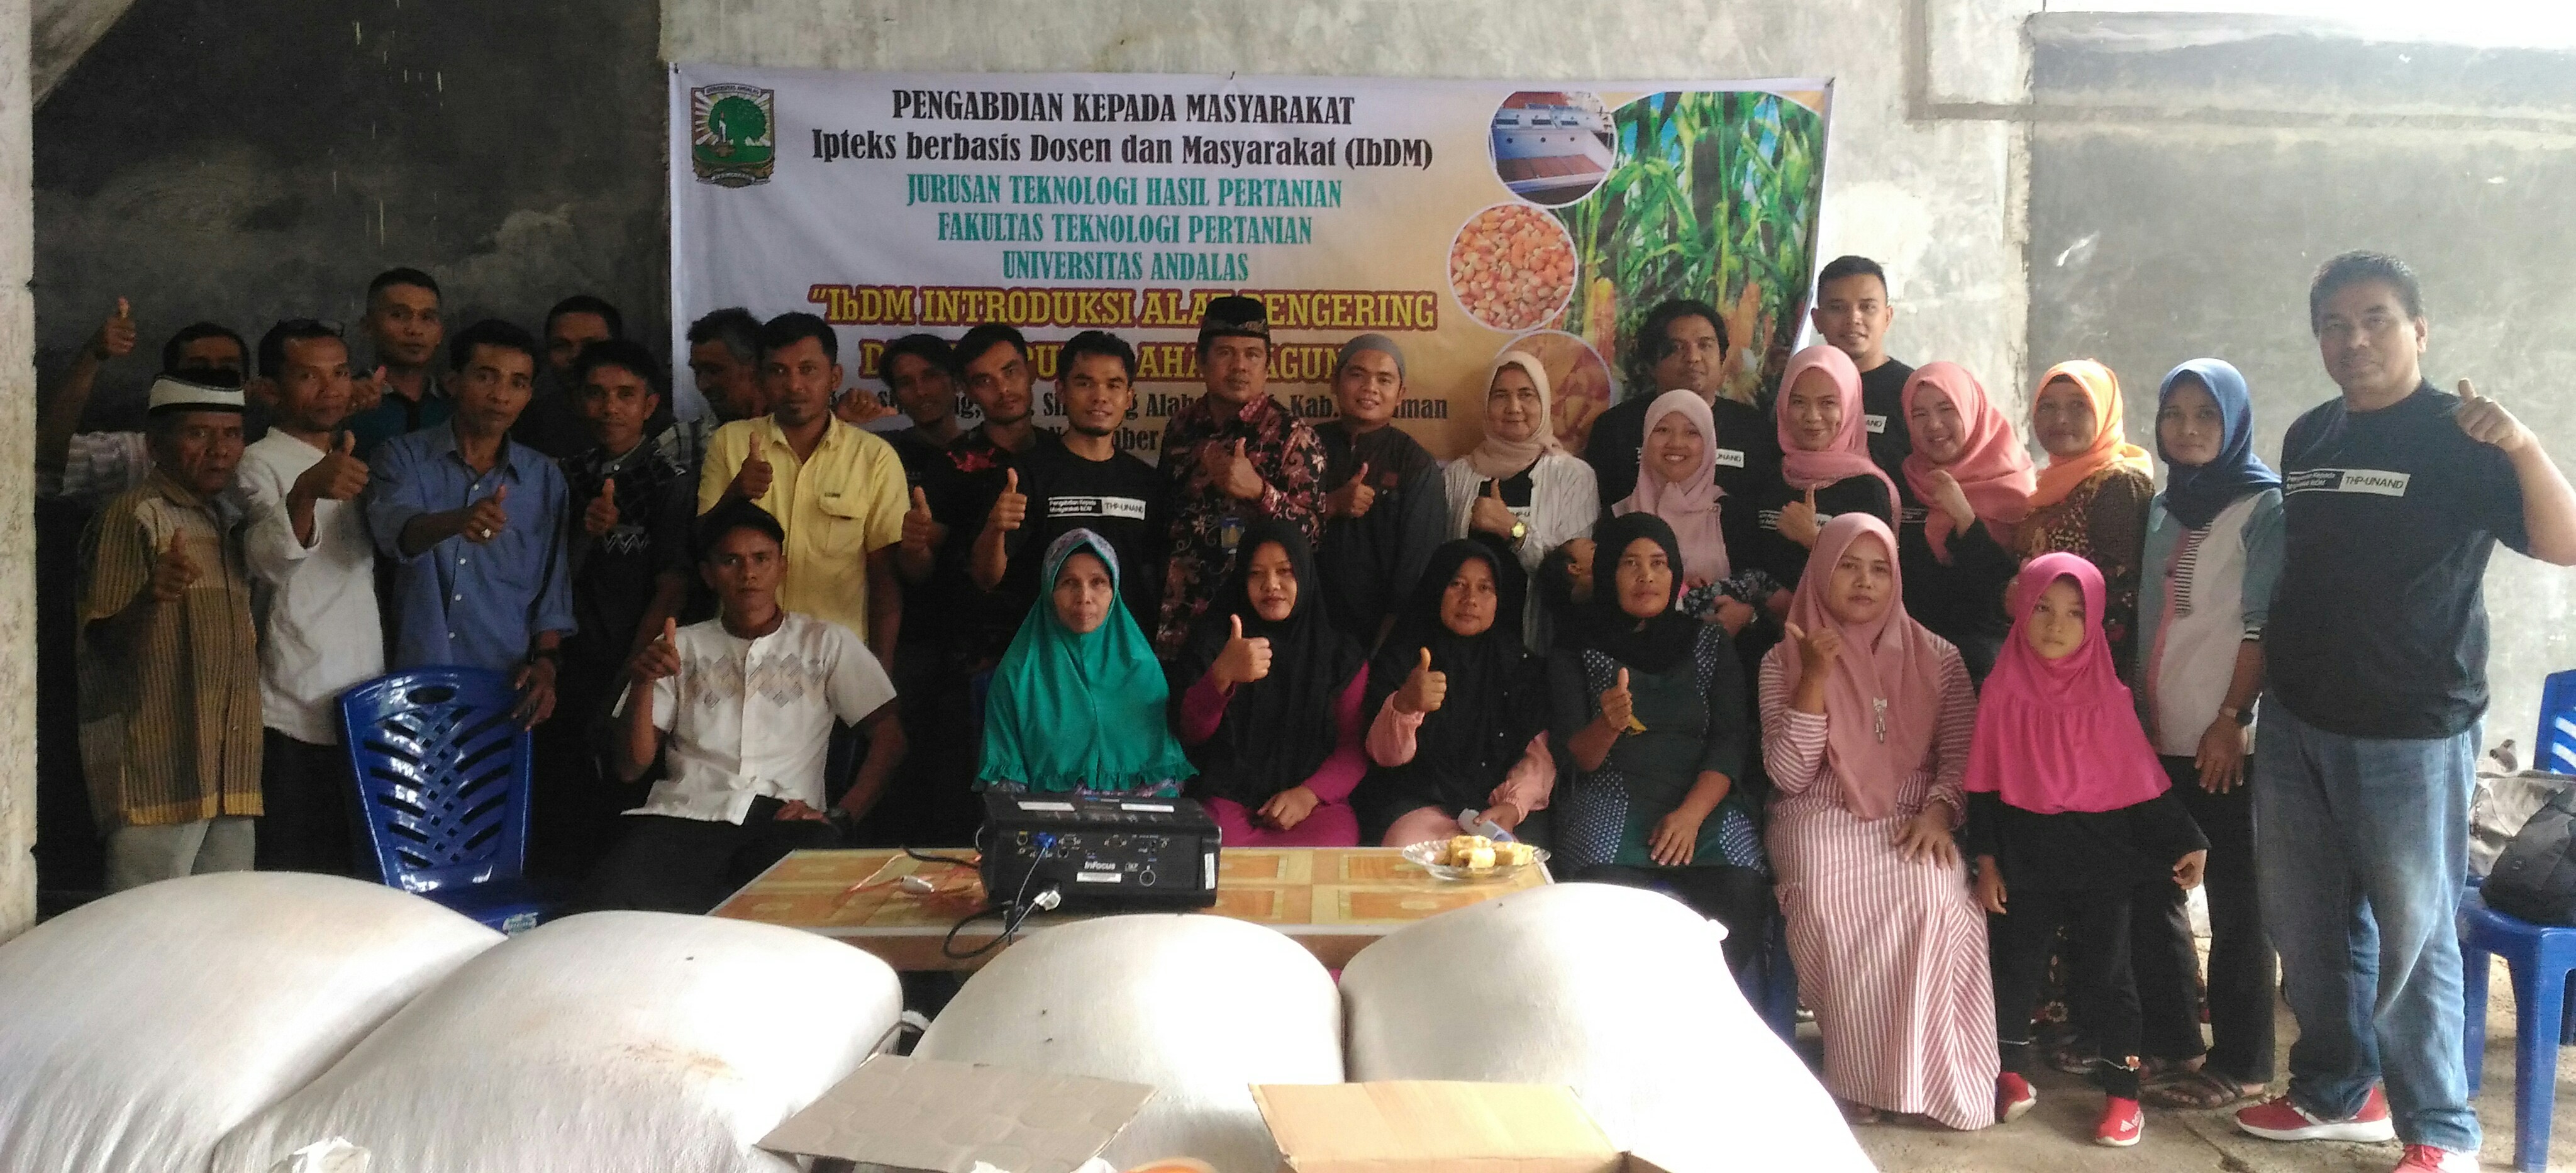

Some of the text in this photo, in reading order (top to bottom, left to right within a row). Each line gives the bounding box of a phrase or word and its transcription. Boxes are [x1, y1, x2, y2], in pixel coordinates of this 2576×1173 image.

[891, 89, 1355, 125] PENGABDIAN KEPADA MASYARAKAT
[811, 128, 1433, 171] Ipteks berbasis Dosen dan Masyarakat (IbDM)
[906, 173, 1343, 209] JURUSAN TEKNOLOGI HASIL PERTANIAN
[937, 212, 1313, 245] FAKULTAS TEKNOLOGI PERTANIAN
[1002, 250, 1249, 282] UNIVERSITAS ANDALAS
[923, 289, 1132, 325] INTRODUKSI
[1141, 291, 1231, 326] ALA
[1242, 292, 1435, 328] ENGERING
[2345, 475, 2404, 489] THP-UNAND
